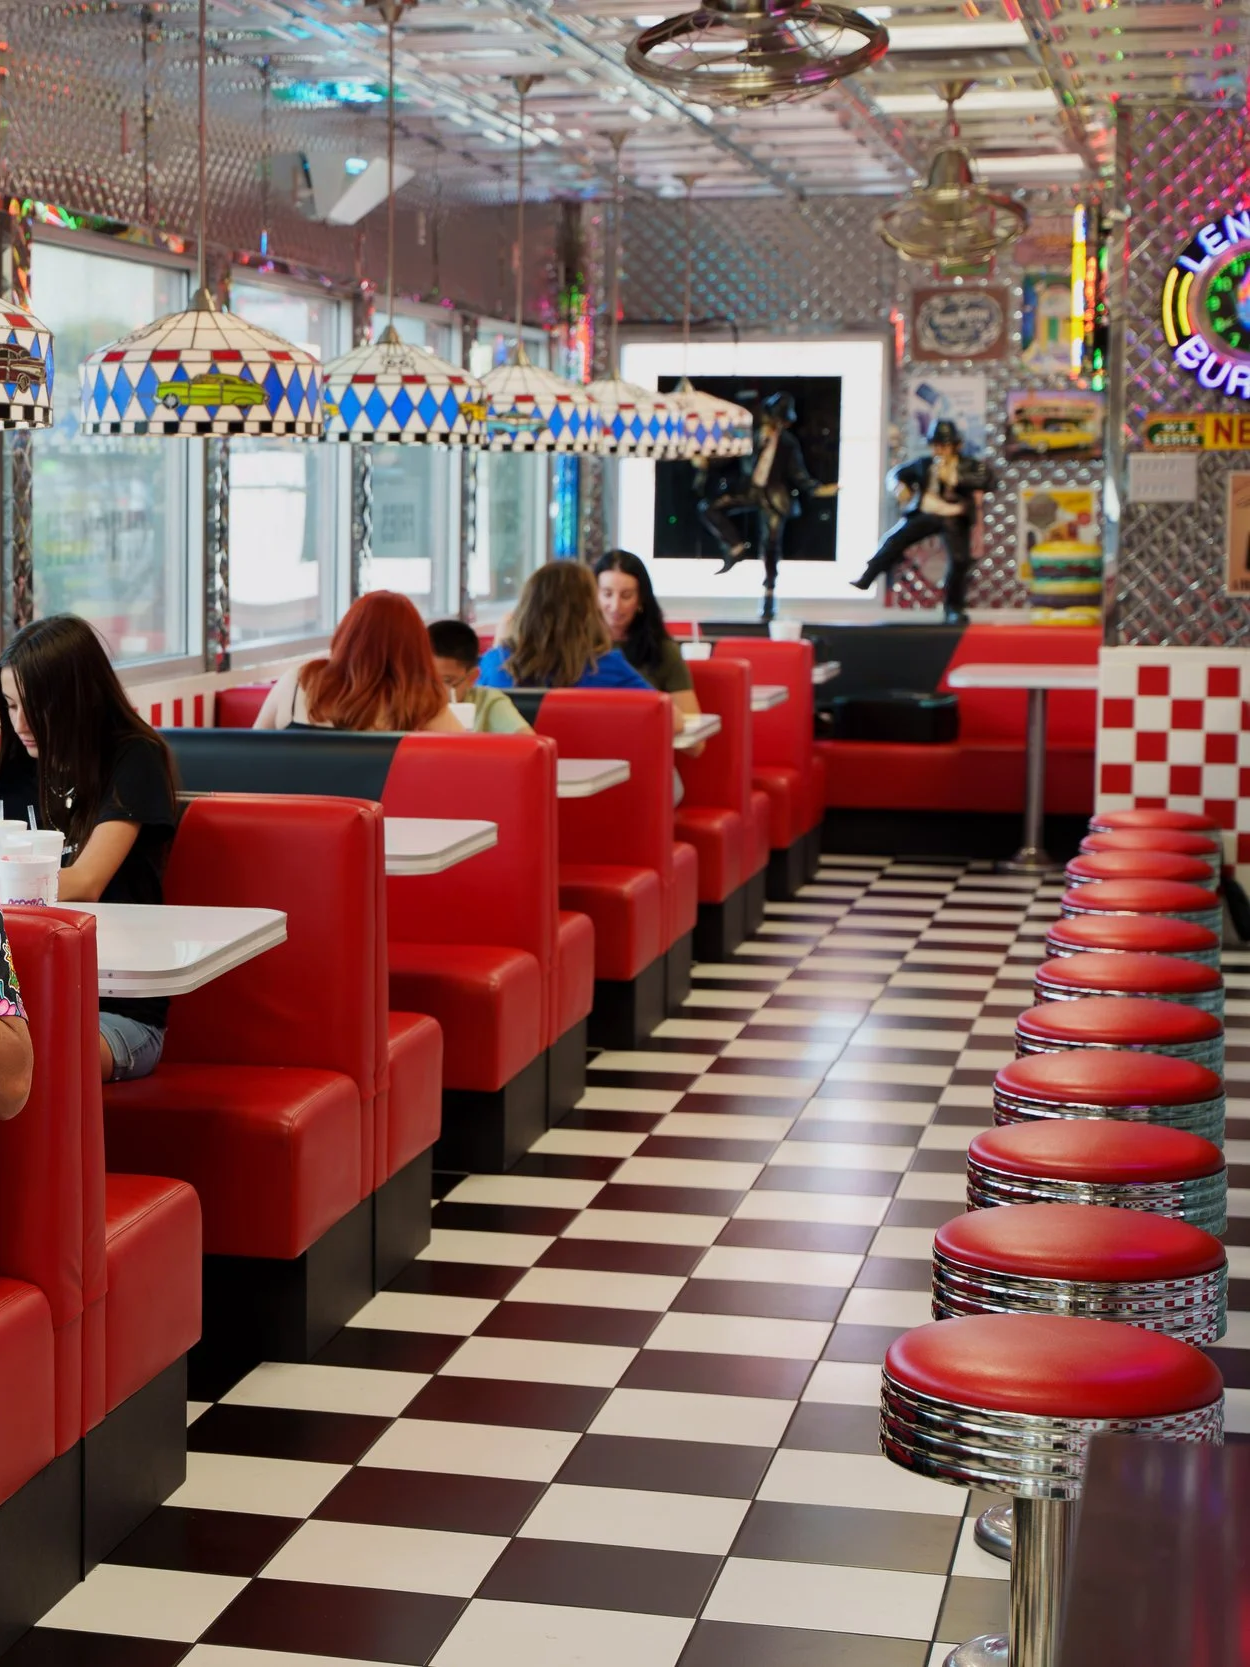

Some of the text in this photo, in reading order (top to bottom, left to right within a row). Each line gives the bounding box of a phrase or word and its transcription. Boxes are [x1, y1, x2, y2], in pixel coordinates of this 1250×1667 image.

[1177, 211, 1250, 272] LEN
[1175, 334, 1250, 399] BUR
[1153, 434, 1199, 446] SERVE
